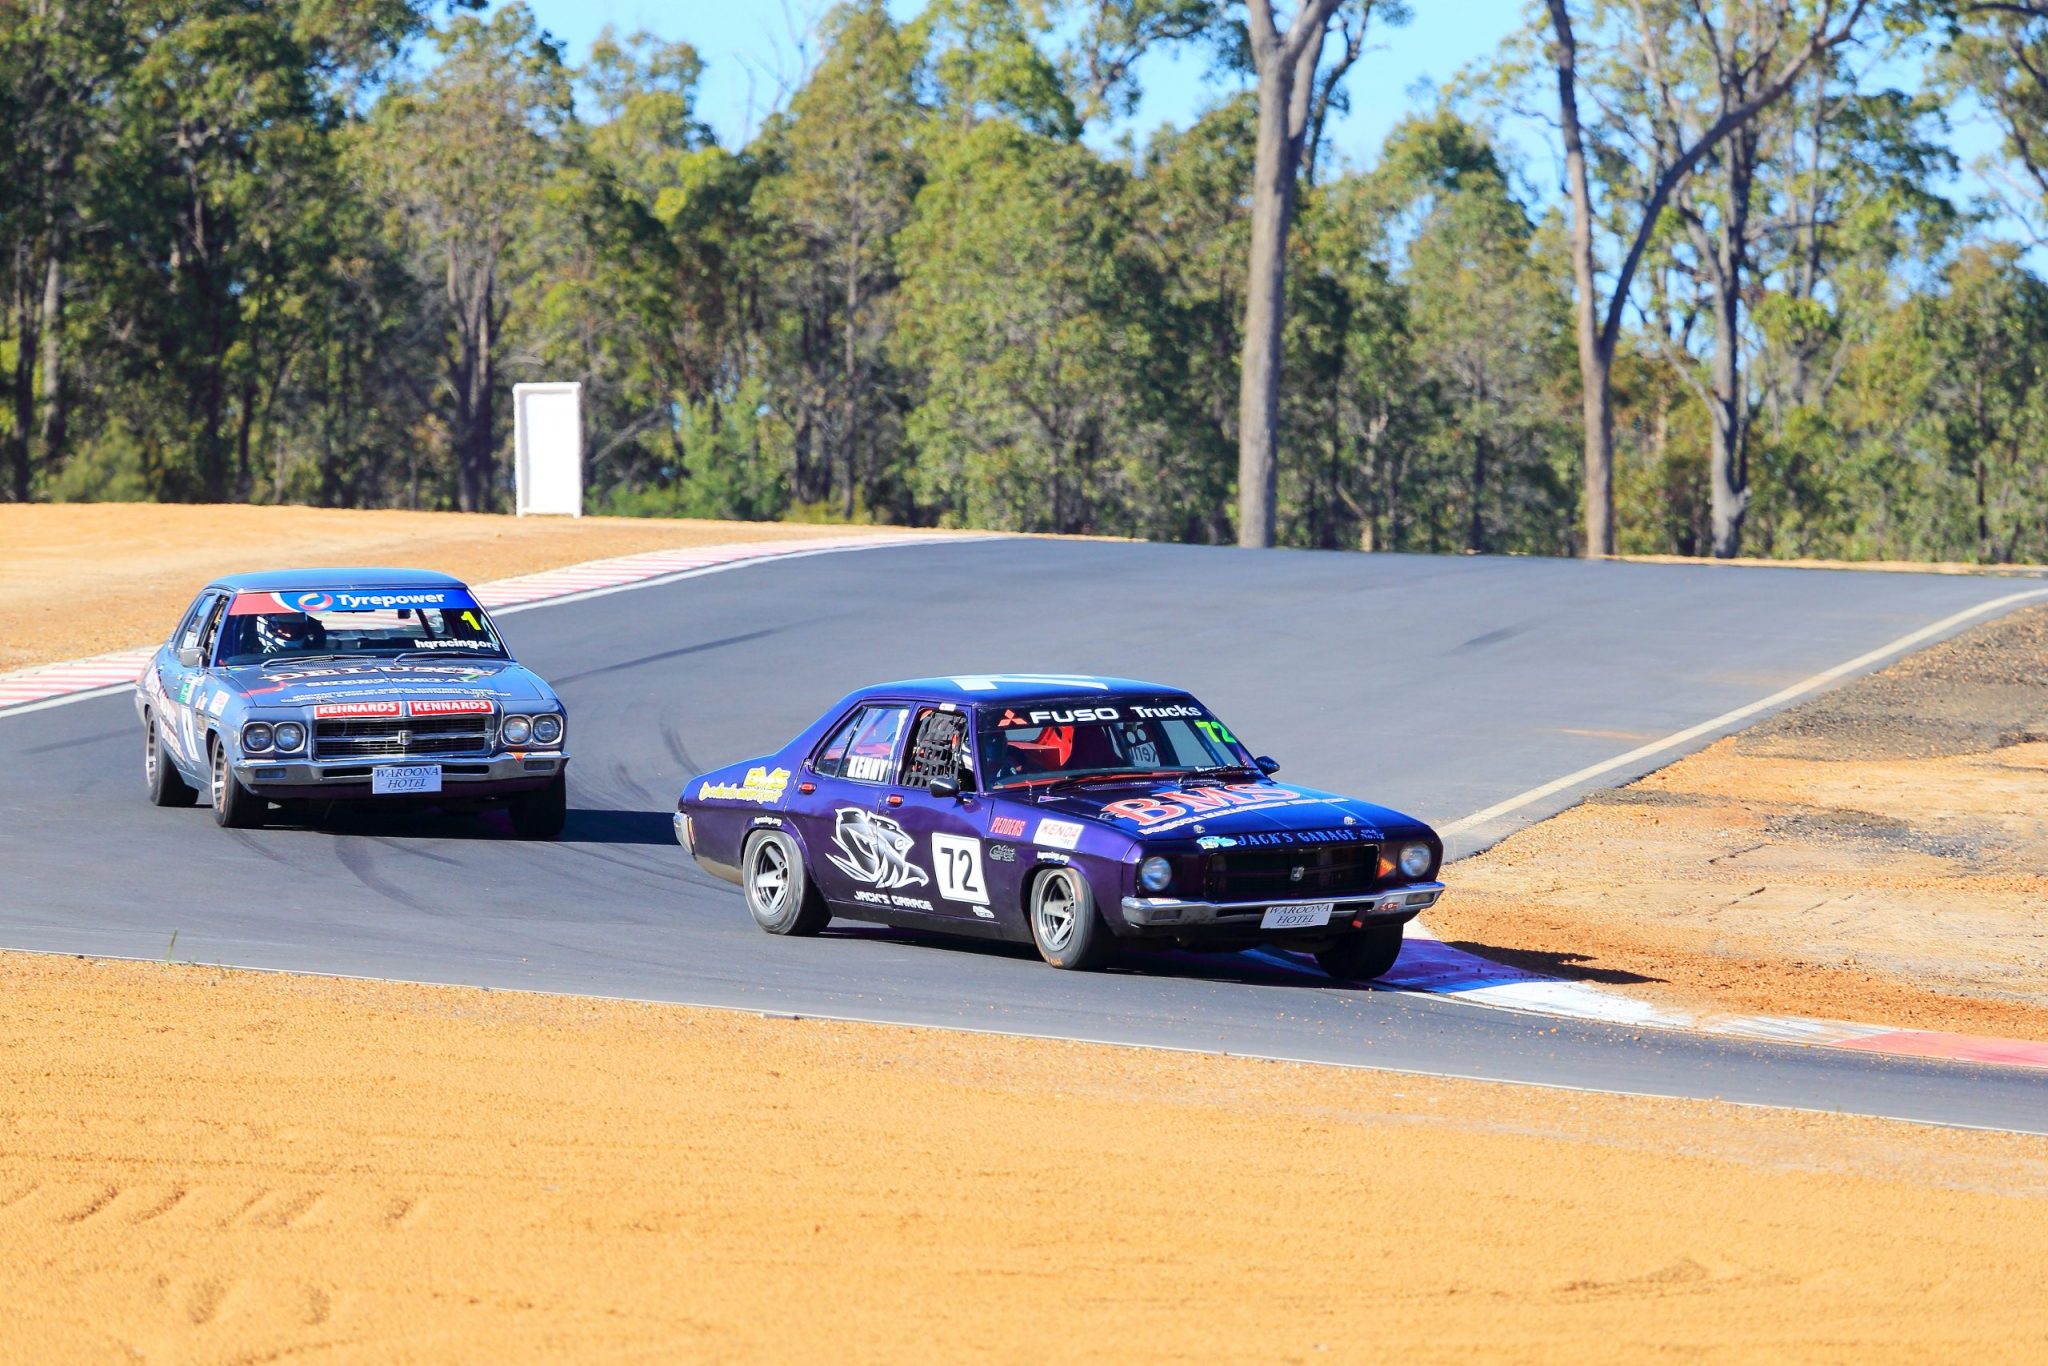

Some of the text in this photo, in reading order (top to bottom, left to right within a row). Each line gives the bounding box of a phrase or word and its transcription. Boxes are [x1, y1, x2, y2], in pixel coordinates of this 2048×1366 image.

[336, 592, 445, 608] Tyrepower
[460, 610, 481, 631] 1
[414, 638, 500, 652] hqracing.org
[319, 702, 397, 715] KENNARDS
[414, 700, 488, 712] KENNARDS
[1029, 704, 1202, 724] FUSO Trucks
[1195, 719, 1237, 743] 72
[376, 767, 439, 778] WAROONA
[387, 778, 426, 788] HOTEL
[1101, 783, 1303, 827] BMS
[990, 816, 1026, 837] PEDDERS
[1041, 822, 1080, 838] KENDA
[1237, 832, 1294, 847] JACK'S
[1297, 829, 1358, 843] GARAGE
[940, 847, 978, 892] 72
[854, 890, 934, 911] JACK'S GARAGE
[1269, 904, 1330, 915] WAROONA
[1276, 914, 1315, 925] HOTEL
